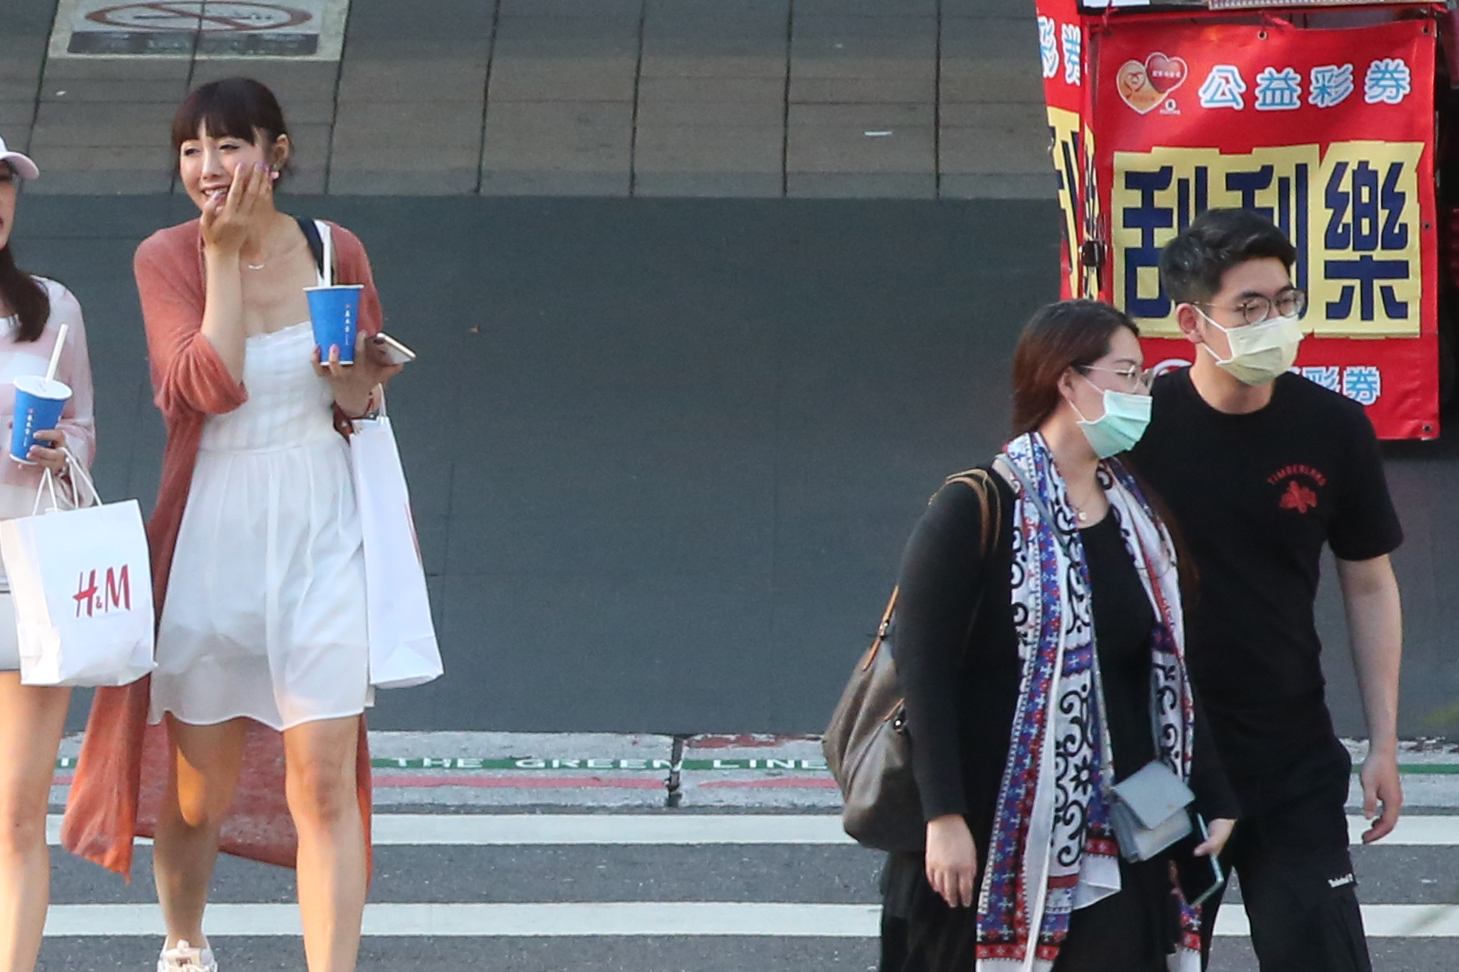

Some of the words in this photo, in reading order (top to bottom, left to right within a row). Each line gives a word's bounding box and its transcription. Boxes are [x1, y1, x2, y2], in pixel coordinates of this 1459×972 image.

[1198, 58, 1411, 110] 公益彩券
[72, 563, 130, 618] H&M
[392, 757, 484, 768] THE
[514, 758, 683, 771] GREEN
[712, 758, 829, 770] LINE
